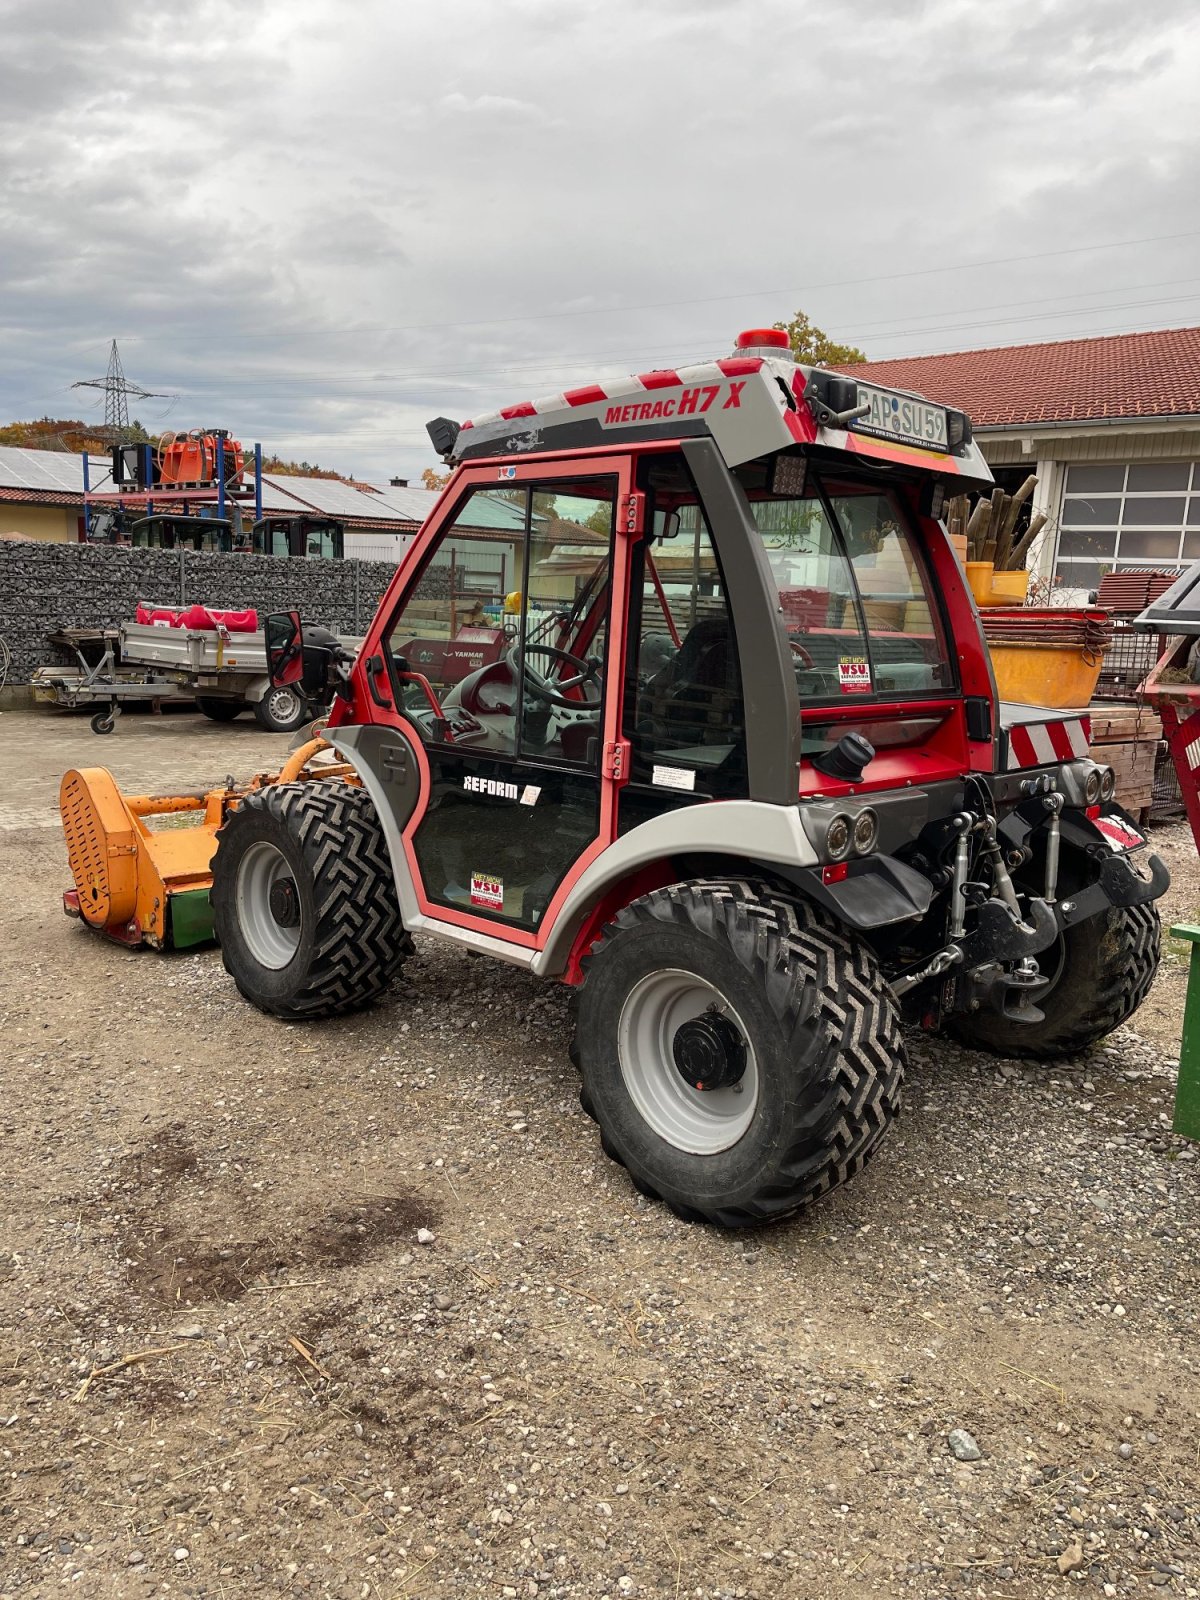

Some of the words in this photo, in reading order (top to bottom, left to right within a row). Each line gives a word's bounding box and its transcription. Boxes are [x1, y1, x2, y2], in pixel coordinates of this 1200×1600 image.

[605, 399, 676, 424] METRAC
[677, 385, 720, 415] H7
[722, 381, 746, 409] X
[902, 402, 922, 437] SU
[925, 408, 944, 441] 59
[454, 650, 484, 659] YANMAR
[463, 775, 518, 800] REFORM
